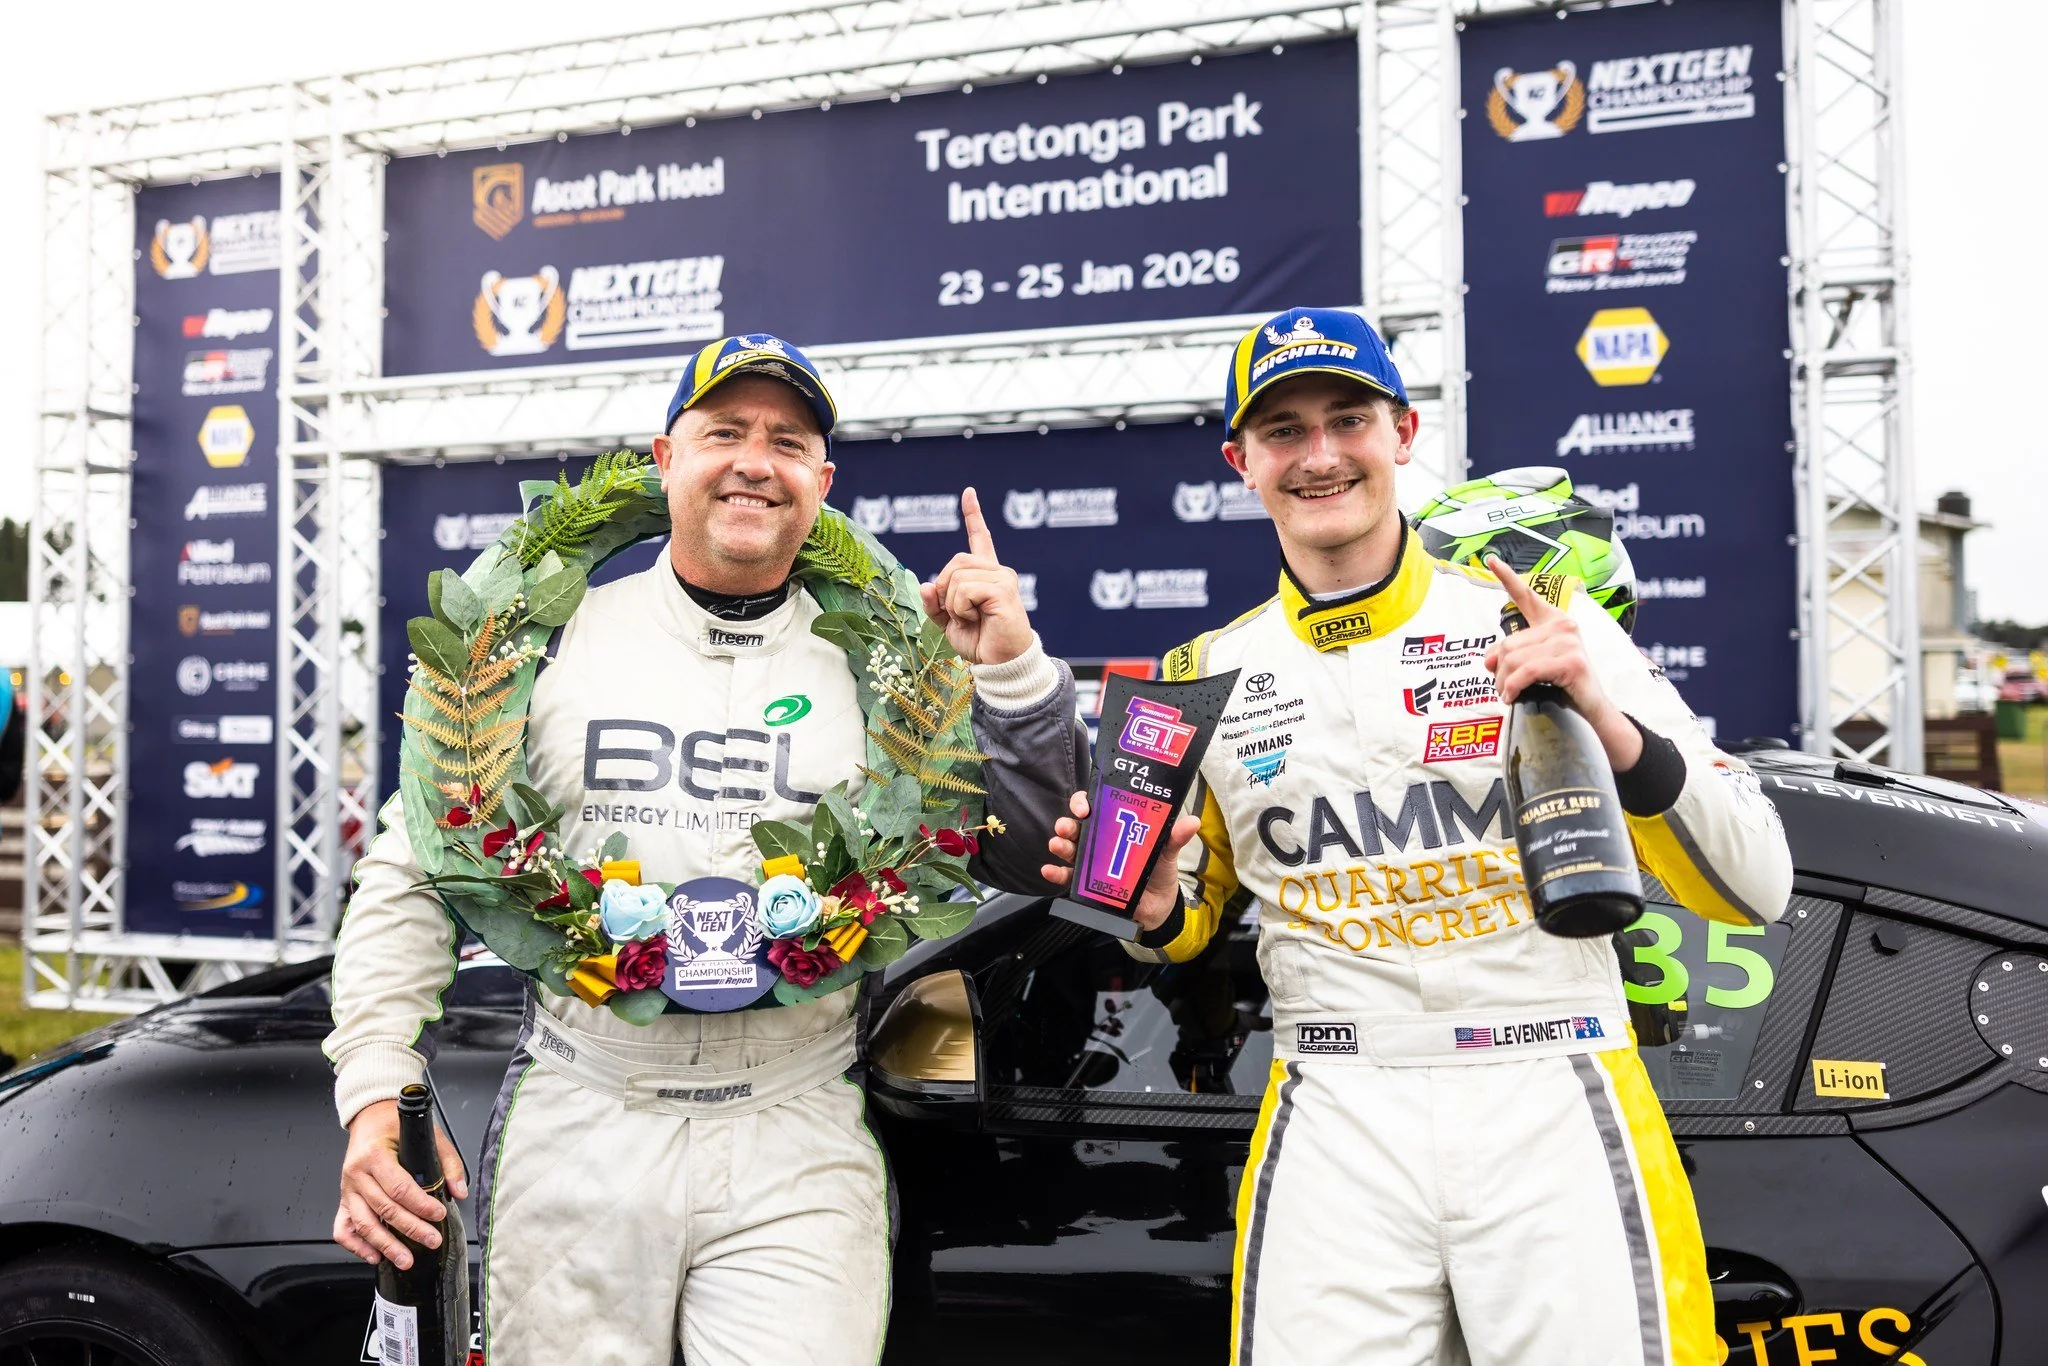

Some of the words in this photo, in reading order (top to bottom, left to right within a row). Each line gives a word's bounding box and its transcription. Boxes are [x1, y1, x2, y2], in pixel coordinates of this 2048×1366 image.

[1588, 45, 1752, 90] NEXTGEN
[1588, 75, 1752, 110] CHAMPIONSHIP
[915, 116, 1147, 172] Teretonga
[1157, 92, 1263, 146] Park
[532, 174, 598, 214] Ascot
[599, 164, 656, 207] Park
[657, 156, 725, 201] Hotel
[948, 151, 1229, 224] International
[1578, 179, 1696, 217] Repco
[567, 255, 724, 303] NEXTGEN
[938, 269, 984, 306] 23
[991, 280, 1010, 293] -
[1016, 262, 1064, 299] 25
[1072, 259, 1134, 295] Jan
[1142, 246, 1240, 289] 2026
[1594, 332, 1652, 361] NAPA
[1252, 344, 1356, 382] MICHELIN
[1556, 408, 1696, 457] ALLIANCE
[1488, 507, 1536, 523] BEL
[1614, 513, 1705, 540] oleum
[710, 629, 763, 647] freem
[1316, 616, 1366, 636] rpm
[1316, 628, 1370, 646] RACEWEAR
[1445, 635, 1497, 652] CUP
[1426, 660, 1472, 671] Australia
[1436, 653, 1467, 662] GAZOO
[1244, 690, 1277, 704] TOYOTA
[1139, 705, 1175, 721] Summerset
[1219, 715, 1240, 726] Mike
[1241, 707, 1273, 721] Carney
[1274, 698, 1304, 712] Toyota
[1129, 715, 1191, 751] GT
[1450, 723, 1499, 743] BF
[1126, 738, 1143, 748] NEW
[1144, 743, 1179, 759] ZEALAND
[1237, 733, 1293, 759] HAYMANS
[1427, 741, 1496, 758] RACING
[583, 718, 826, 806] BEL
[1114, 757, 1150, 778] GT4
[1130, 776, 1172, 799] Class
[1109, 788, 1148, 809] Round
[1151, 802, 1162, 813] 2
[1519, 797, 1567, 826] QUARTZ
[1568, 796, 1602, 810] REEF
[1813, 781, 2026, 833] EVENNETT
[582, 804, 669, 826] ENERGY
[1107, 807, 1151, 880] 1ST
[1091, 879, 1129, 900] 2025-26
[697, 911, 731, 922] NEXT
[700, 921, 727, 932] GEN
[678, 966, 753, 978] CHAMPIONSHIP
[1622, 911, 1774, 1009] 35
[725, 977, 753, 985] Repco
[1300, 1026, 1350, 1042] rpm
[1493, 1019, 1573, 1046] L.EVENNETT
[1299, 1043, 1356, 1053] RACEWEAR
[1818, 1067, 1880, 1092] Li-ion
[656, 1088, 691, 1100] GLEN
[693, 1083, 752, 1102] CHAPPEL
